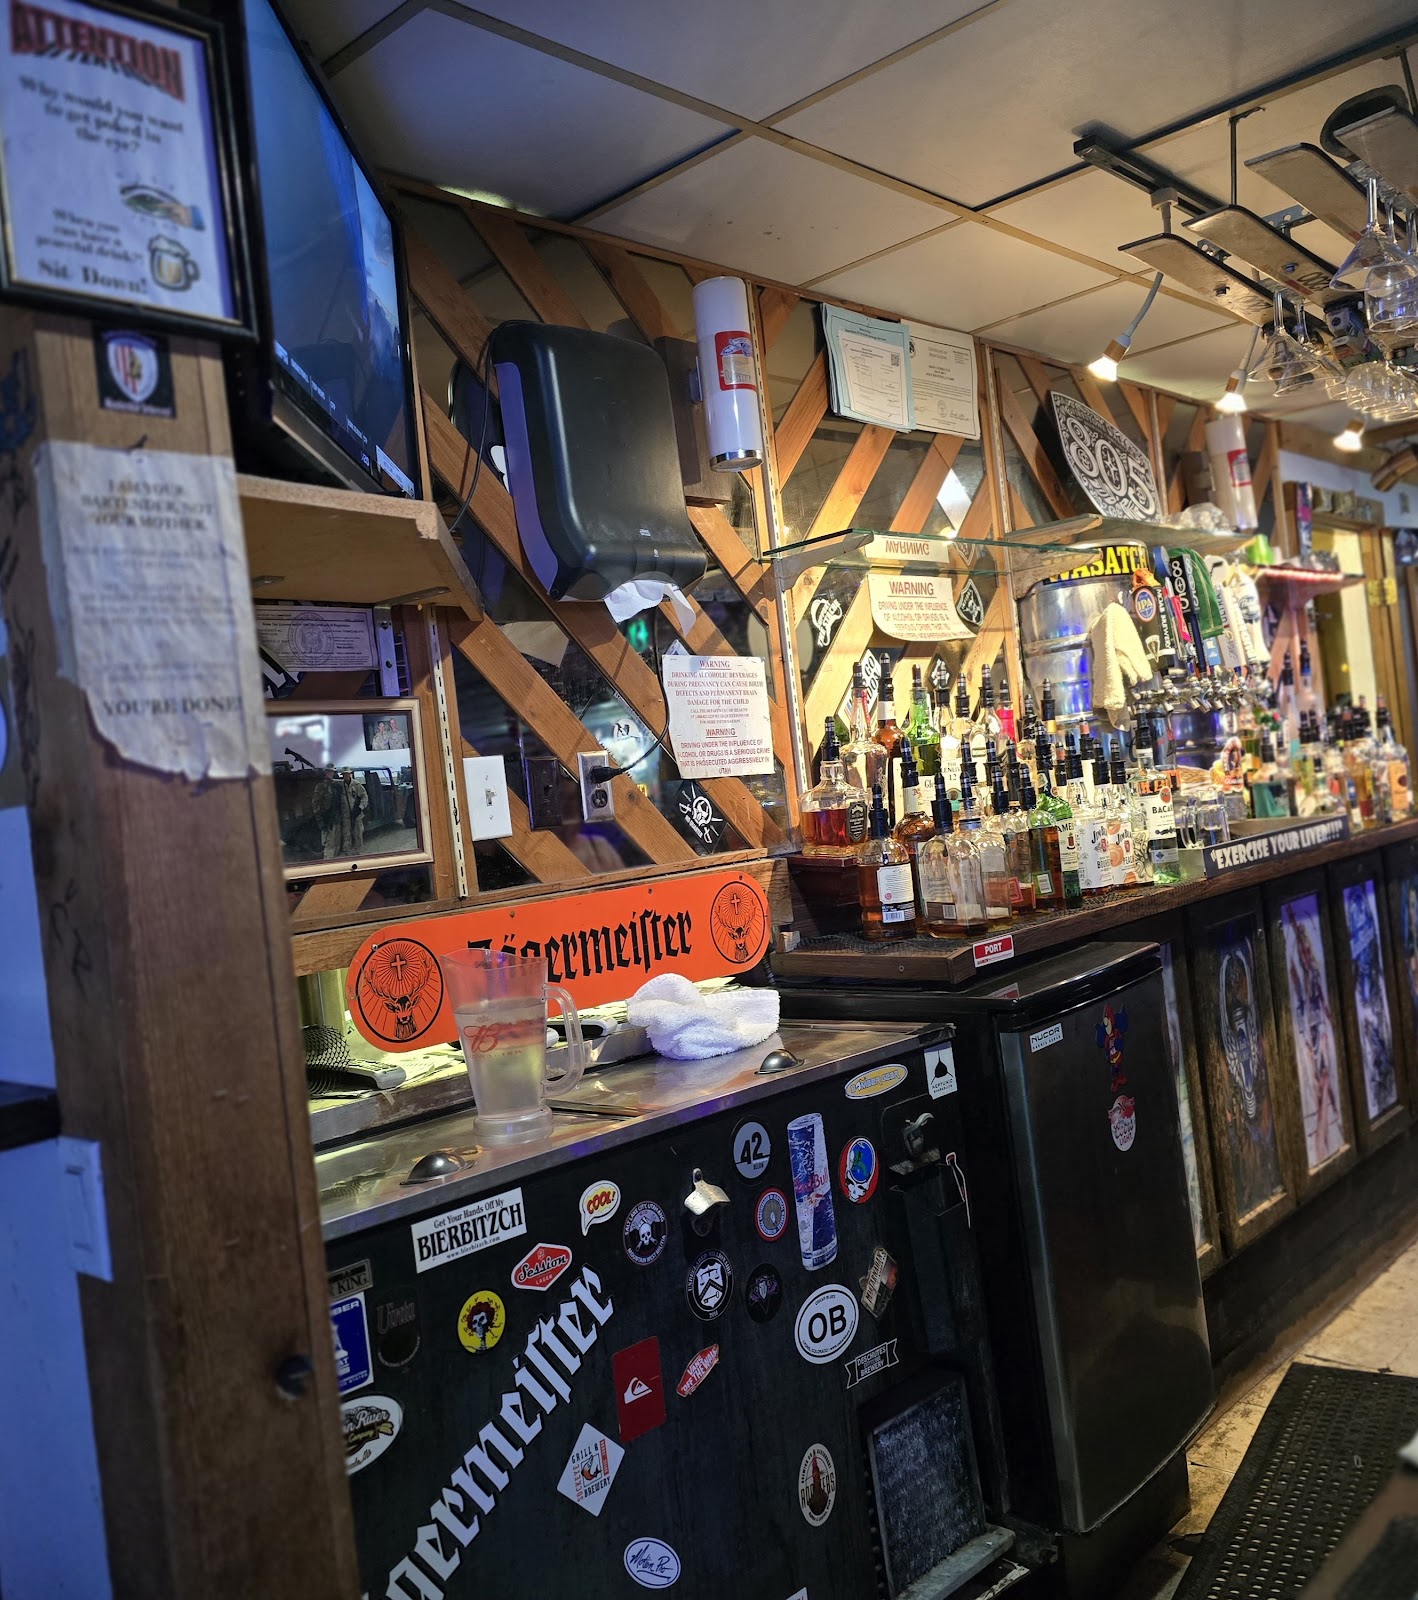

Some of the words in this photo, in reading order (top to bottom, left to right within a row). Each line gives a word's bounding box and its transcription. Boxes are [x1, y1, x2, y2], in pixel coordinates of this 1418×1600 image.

[10, 1, 185, 102] ATTENTION
[1066, 417, 1155, 515] 805
[889, 581, 934, 596] WARNING
[1137, 597, 1153, 611] IPA
[699, 660, 730, 668] WARNING
[706, 727, 736, 736] WARNING
[696, 758, 727, 766] PROSECUTED
[727, 757, 764, 765] AGGRESSIVELY
[949, 773, 957, 781] 12
[1152, 806, 1173, 814] BACA
[1270, 830, 1300, 856] YOUR
[984, 942, 1003, 955] PORT
[1031, 1025, 1061, 1044] NUCOR
[931, 1078, 954, 1091] NEPTUNIC
[740, 1131, 765, 1166] 42
[812, 1169, 831, 1190] Bull
[586, 1190, 616, 1215] COOL!
[433, 1218, 447, 1229] Get
[447, 1212, 463, 1225] Your
[463, 1205, 484, 1219] Hands
[484, 1199, 496, 1211] Off
[495, 1198, 505, 1210] My
[417, 1202, 523, 1262] BIERBITZCH
[446, 1235, 500, 1260] www.bierbitzch.com
[518, 1253, 568, 1283] Session
[337, 1272, 367, 1294] KING
[535, 1274, 553, 1285] LAGER
[808, 1304, 847, 1344] OB
[686, 1356, 704, 1376] VANS
[857, 1346, 887, 1367] DESCHUTES
[692, 1366, 707, 1384] THE
[860, 1360, 885, 1377] BREWERY
[356, 1410, 389, 1430] River
[571, 1446, 592, 1465] GRILL
[593, 1442, 599, 1452] &
[572, 1463, 584, 1502] SOCKEYE
[583, 1475, 611, 1498] BREWERY
